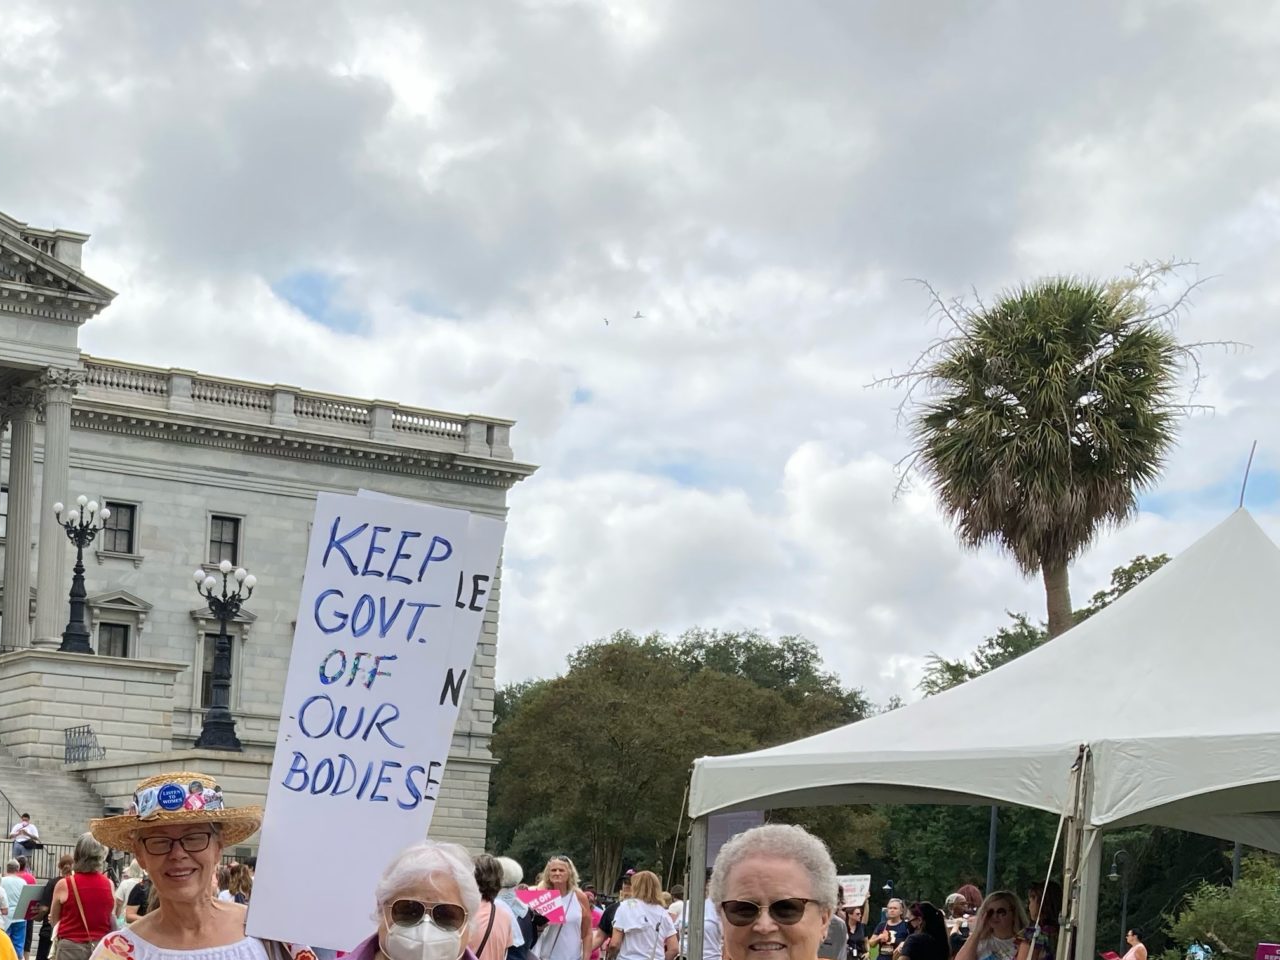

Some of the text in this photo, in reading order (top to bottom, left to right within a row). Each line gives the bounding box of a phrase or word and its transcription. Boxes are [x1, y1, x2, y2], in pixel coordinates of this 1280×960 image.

[322, 516, 452, 584] KEEP
[314, 589, 441, 644] GOVT.
[319, 649, 398, 690] OFF
[439, 668, 467, 708] N
[298, 693, 406, 748] OUR
[281, 751, 426, 811] BODIES
